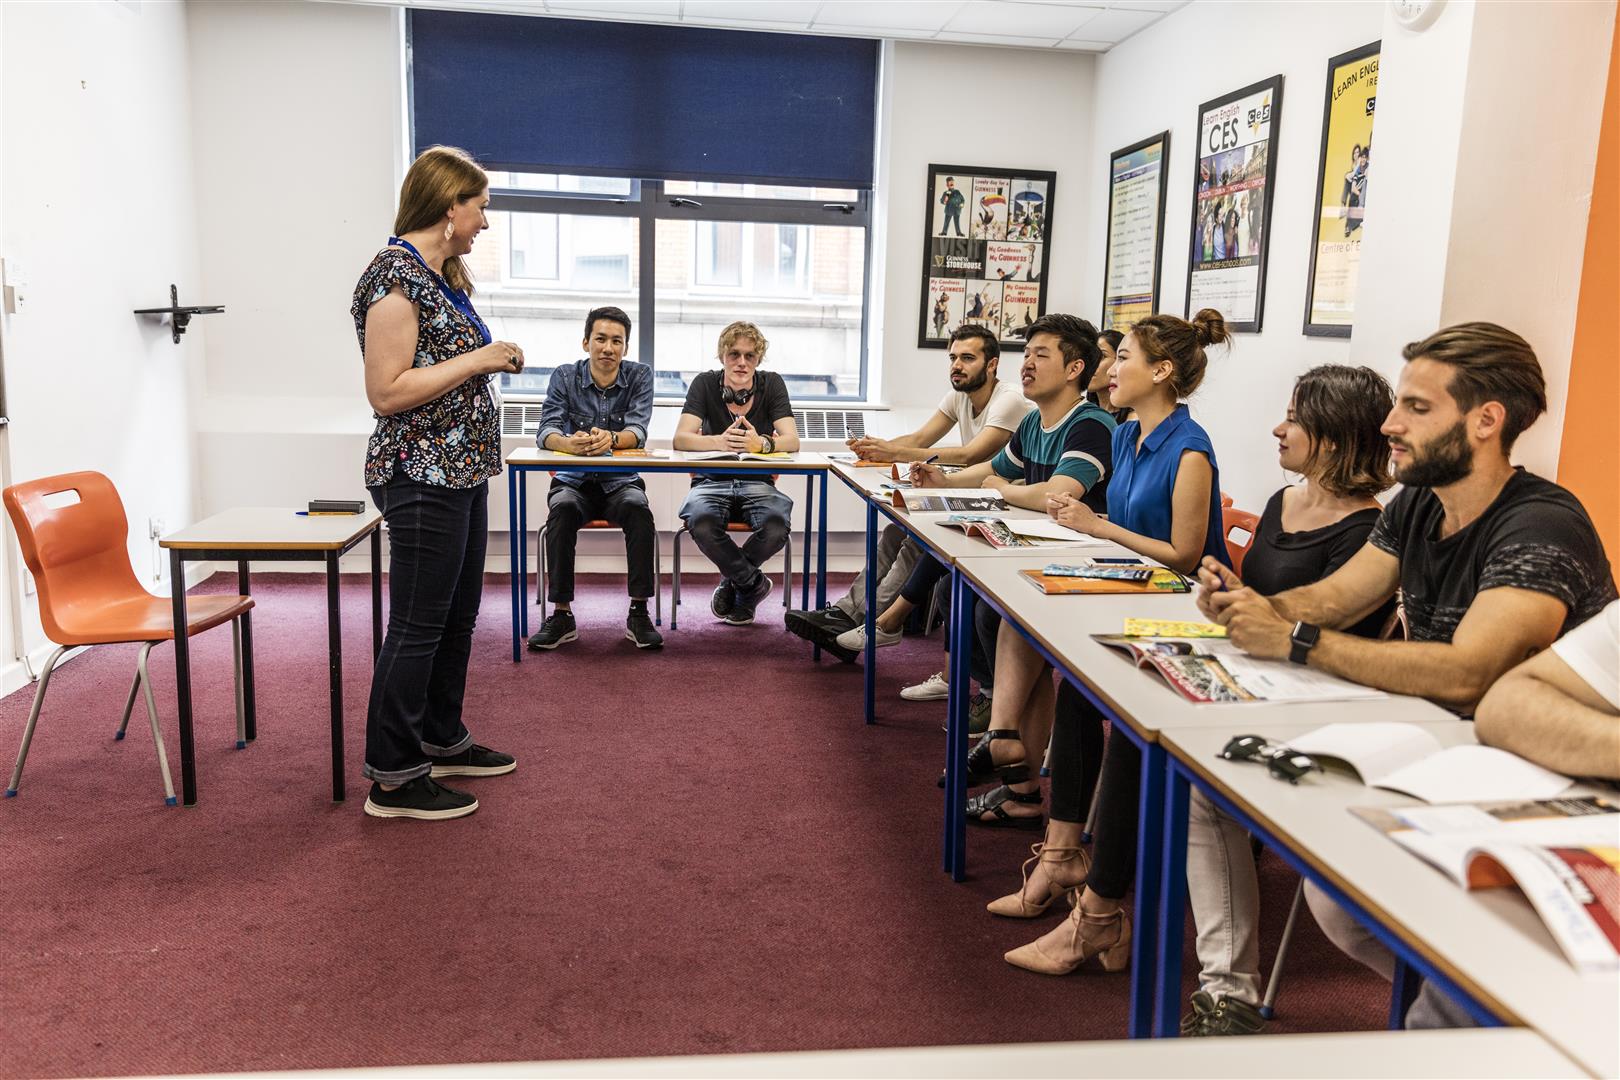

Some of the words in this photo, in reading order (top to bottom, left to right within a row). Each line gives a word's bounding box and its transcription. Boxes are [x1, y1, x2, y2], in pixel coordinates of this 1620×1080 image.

[1333, 72, 1358, 101] LEARN
[1359, 60, 1379, 79] ENGL
[1366, 76, 1378, 87] IRE
[1203, 113, 1219, 126] Learn
[1220, 104, 1240, 121] English
[1209, 117, 1239, 153] CES
[946, 261, 982, 270] STOREHOUSE
[1004, 294, 1037, 304] GUINNESS
